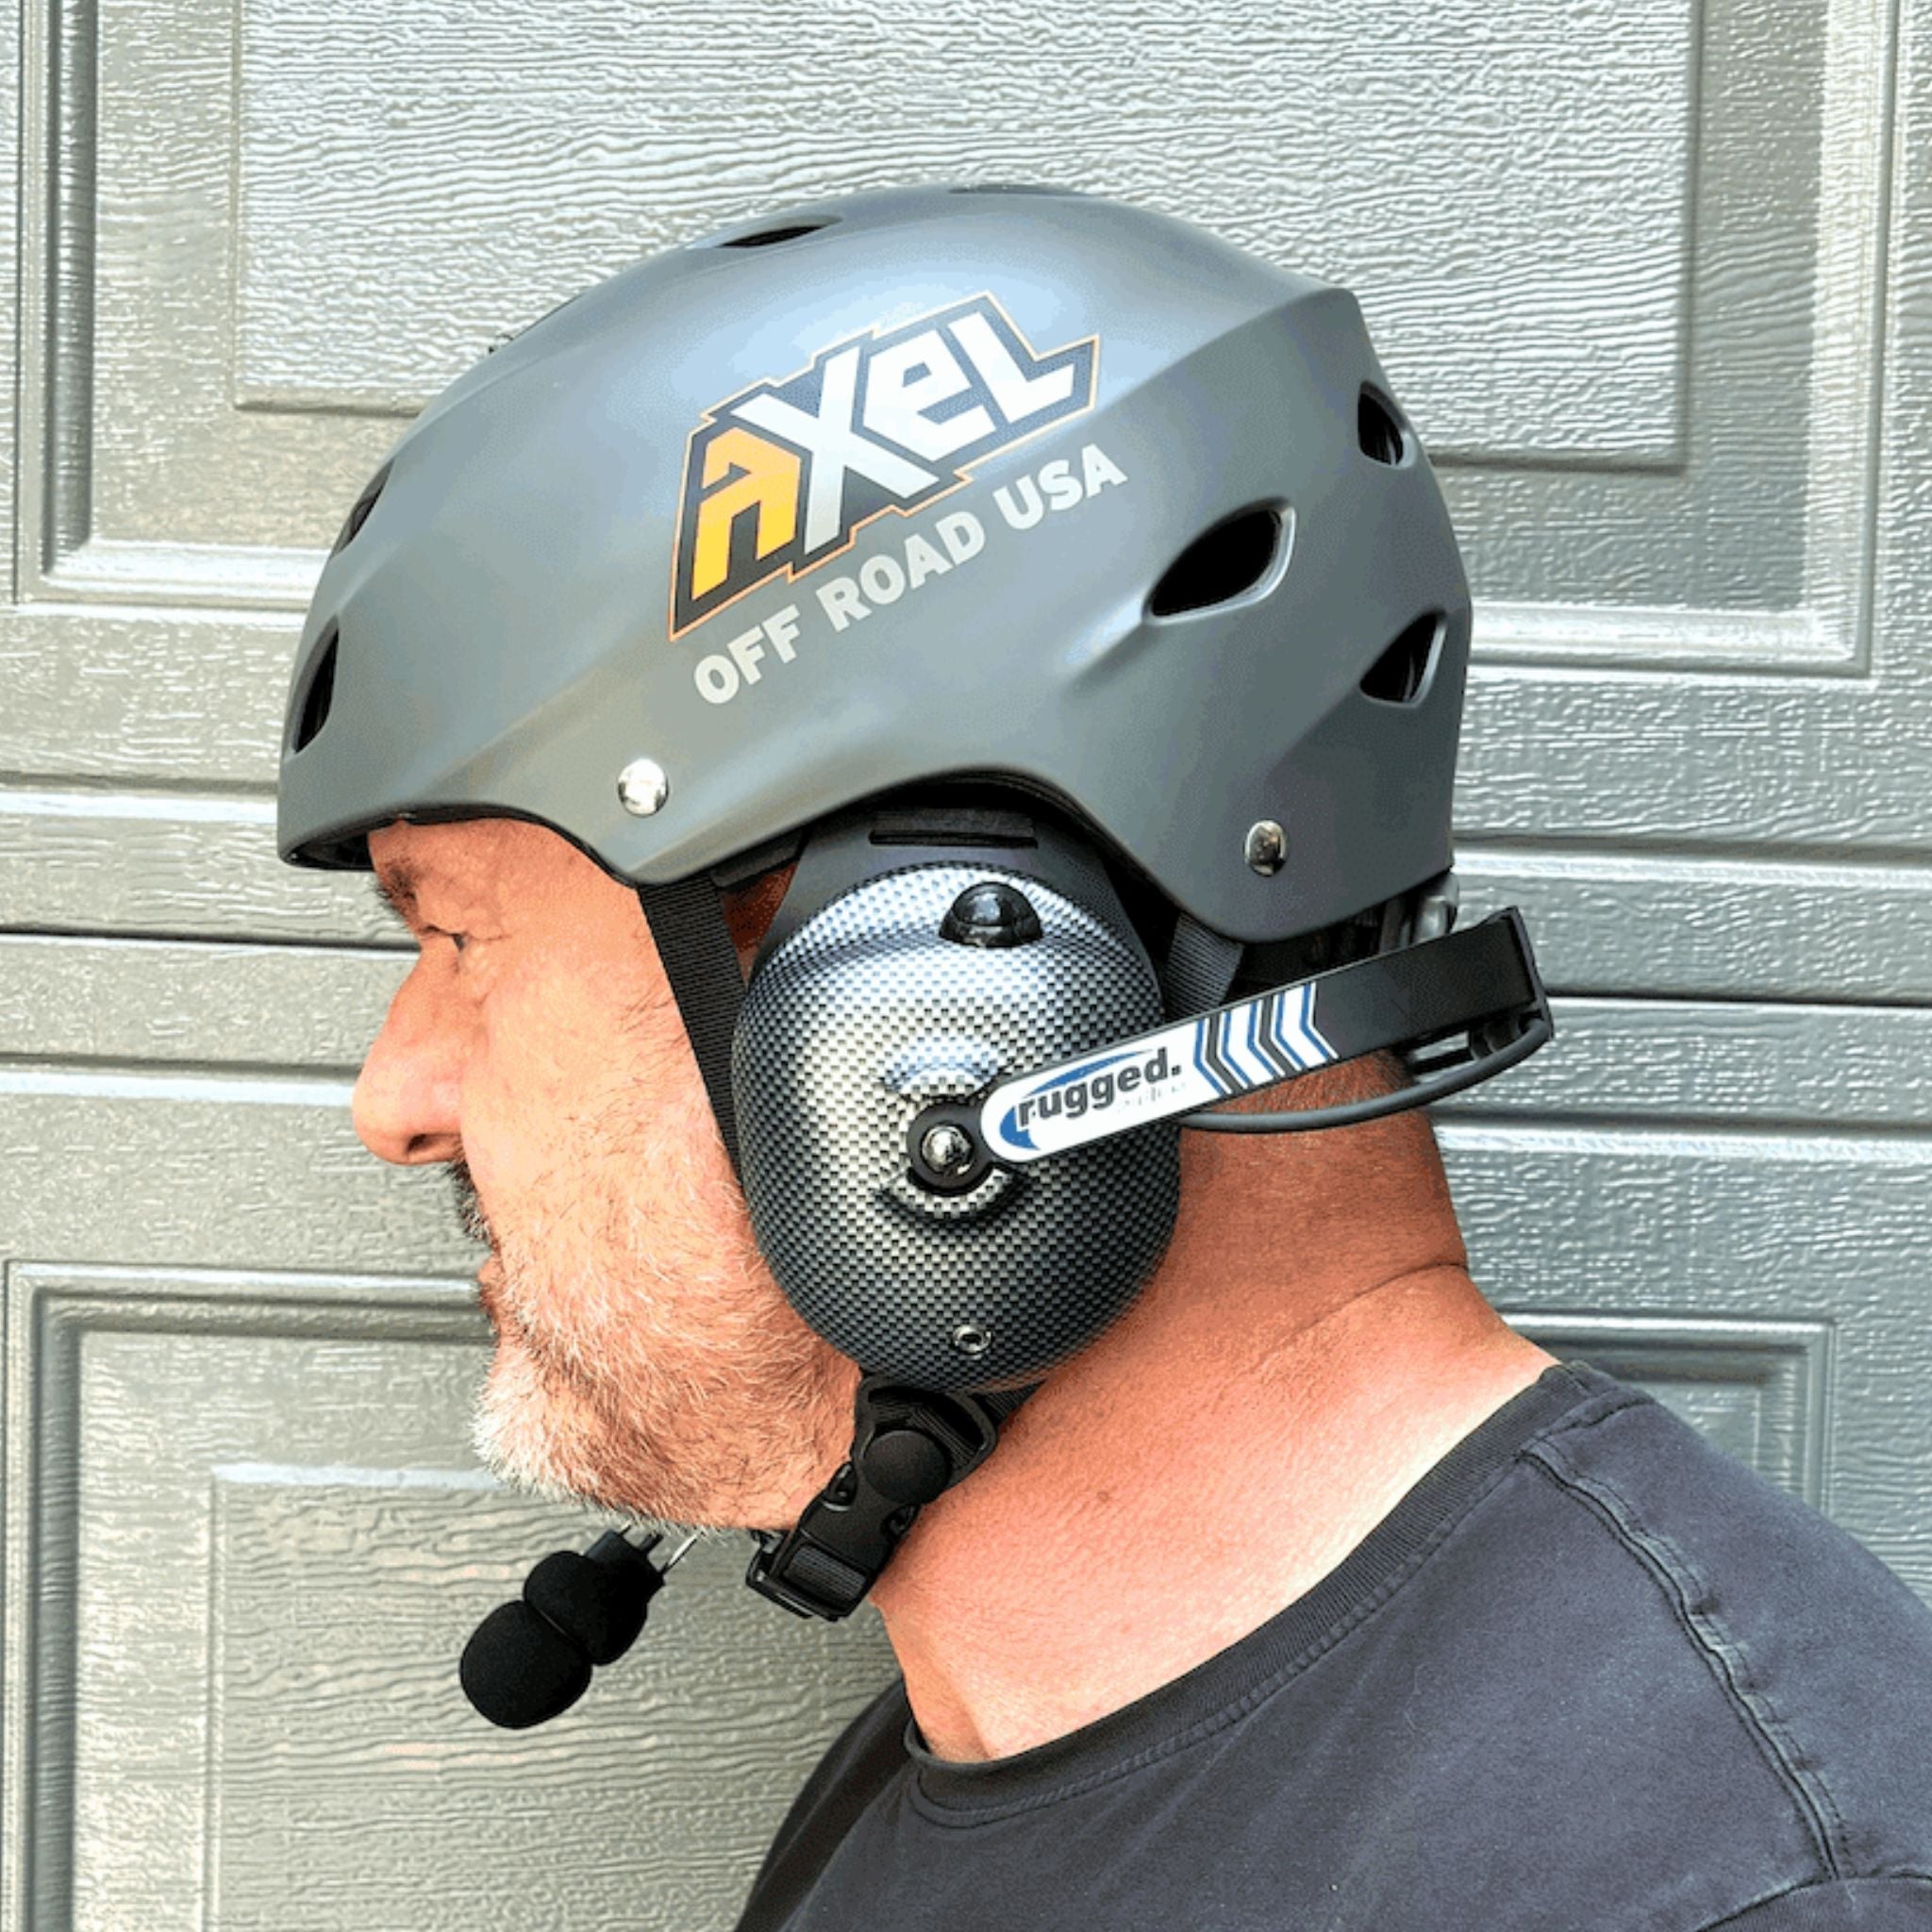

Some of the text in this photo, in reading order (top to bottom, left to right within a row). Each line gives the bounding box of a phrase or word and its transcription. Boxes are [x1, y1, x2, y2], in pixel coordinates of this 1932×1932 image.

[694, 443, 1127, 704] OFF ROAD USA
